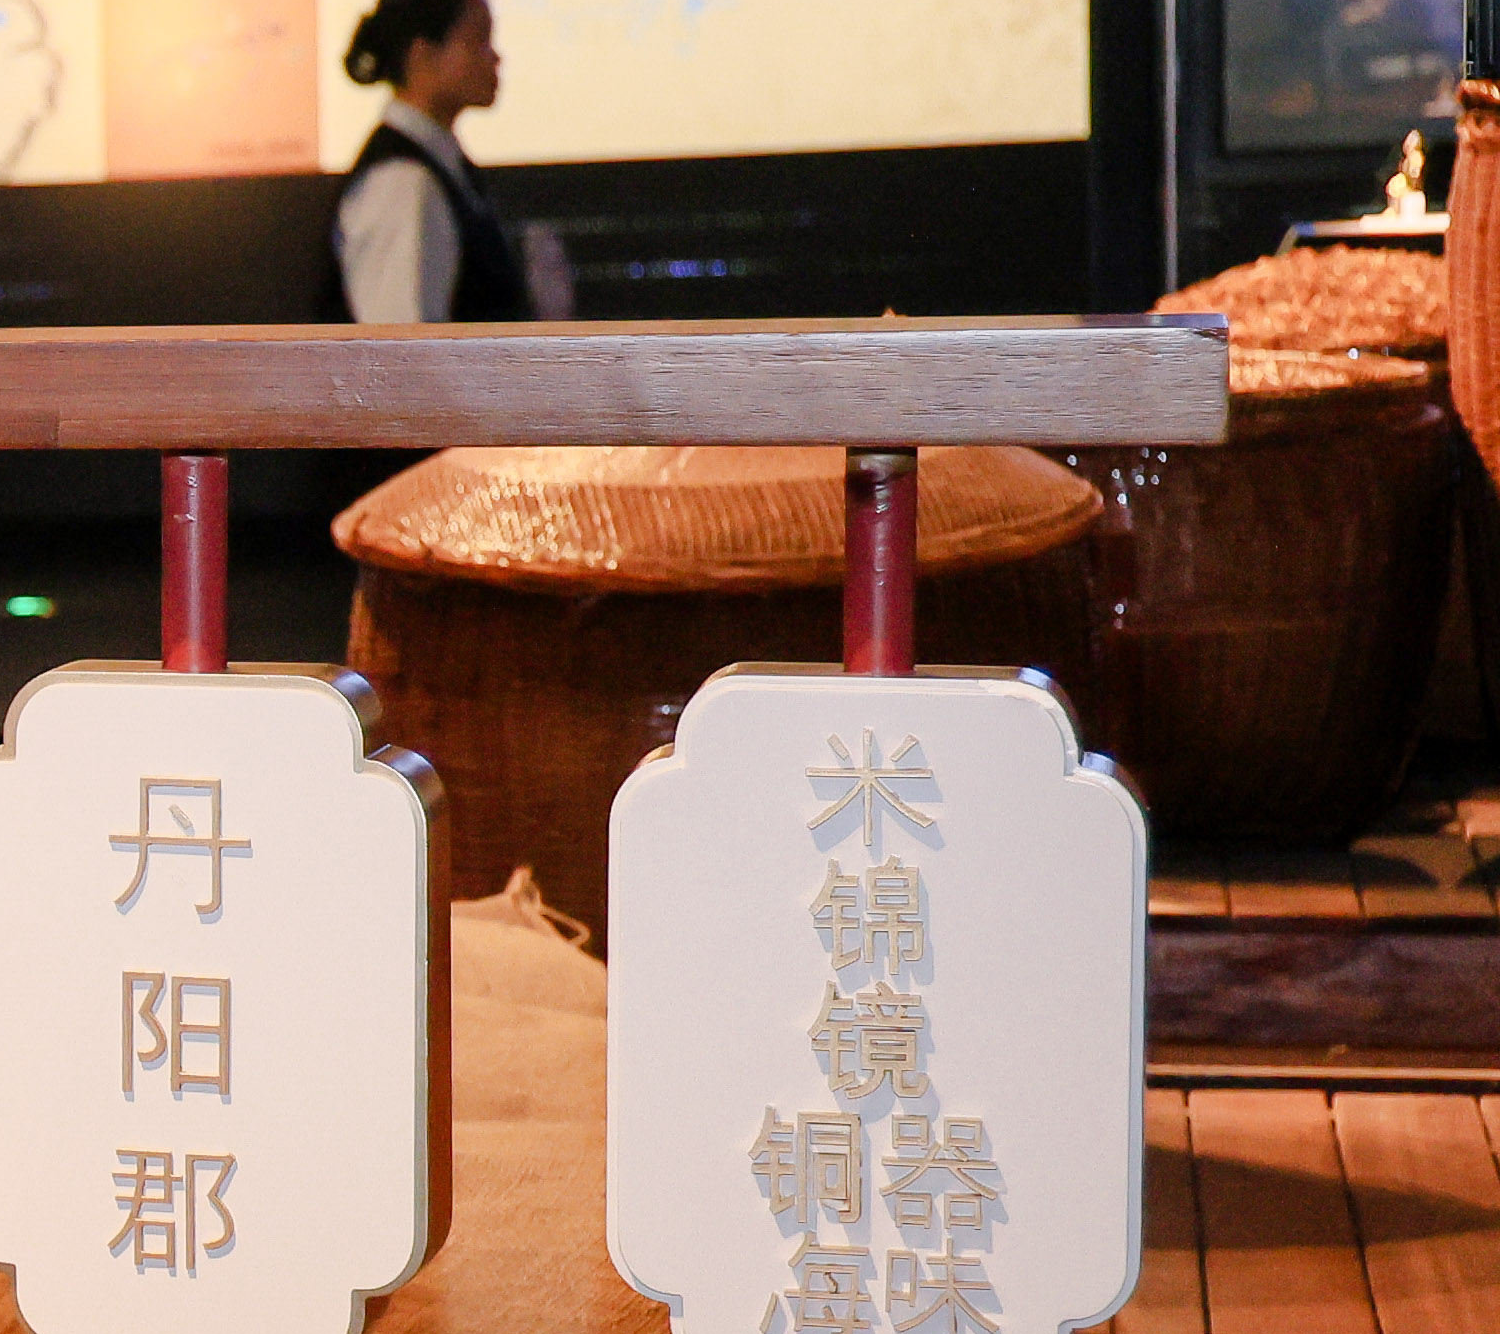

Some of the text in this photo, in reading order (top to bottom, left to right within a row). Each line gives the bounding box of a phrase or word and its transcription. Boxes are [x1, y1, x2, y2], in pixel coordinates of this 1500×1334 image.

[805, 727, 934, 846] 米
[808, 855, 925, 975] 锦
[108, 777, 252, 1269] 丹阳郡
[807, 980, 929, 1099] 镜
[747, 1105, 998, 1230] 铜器
